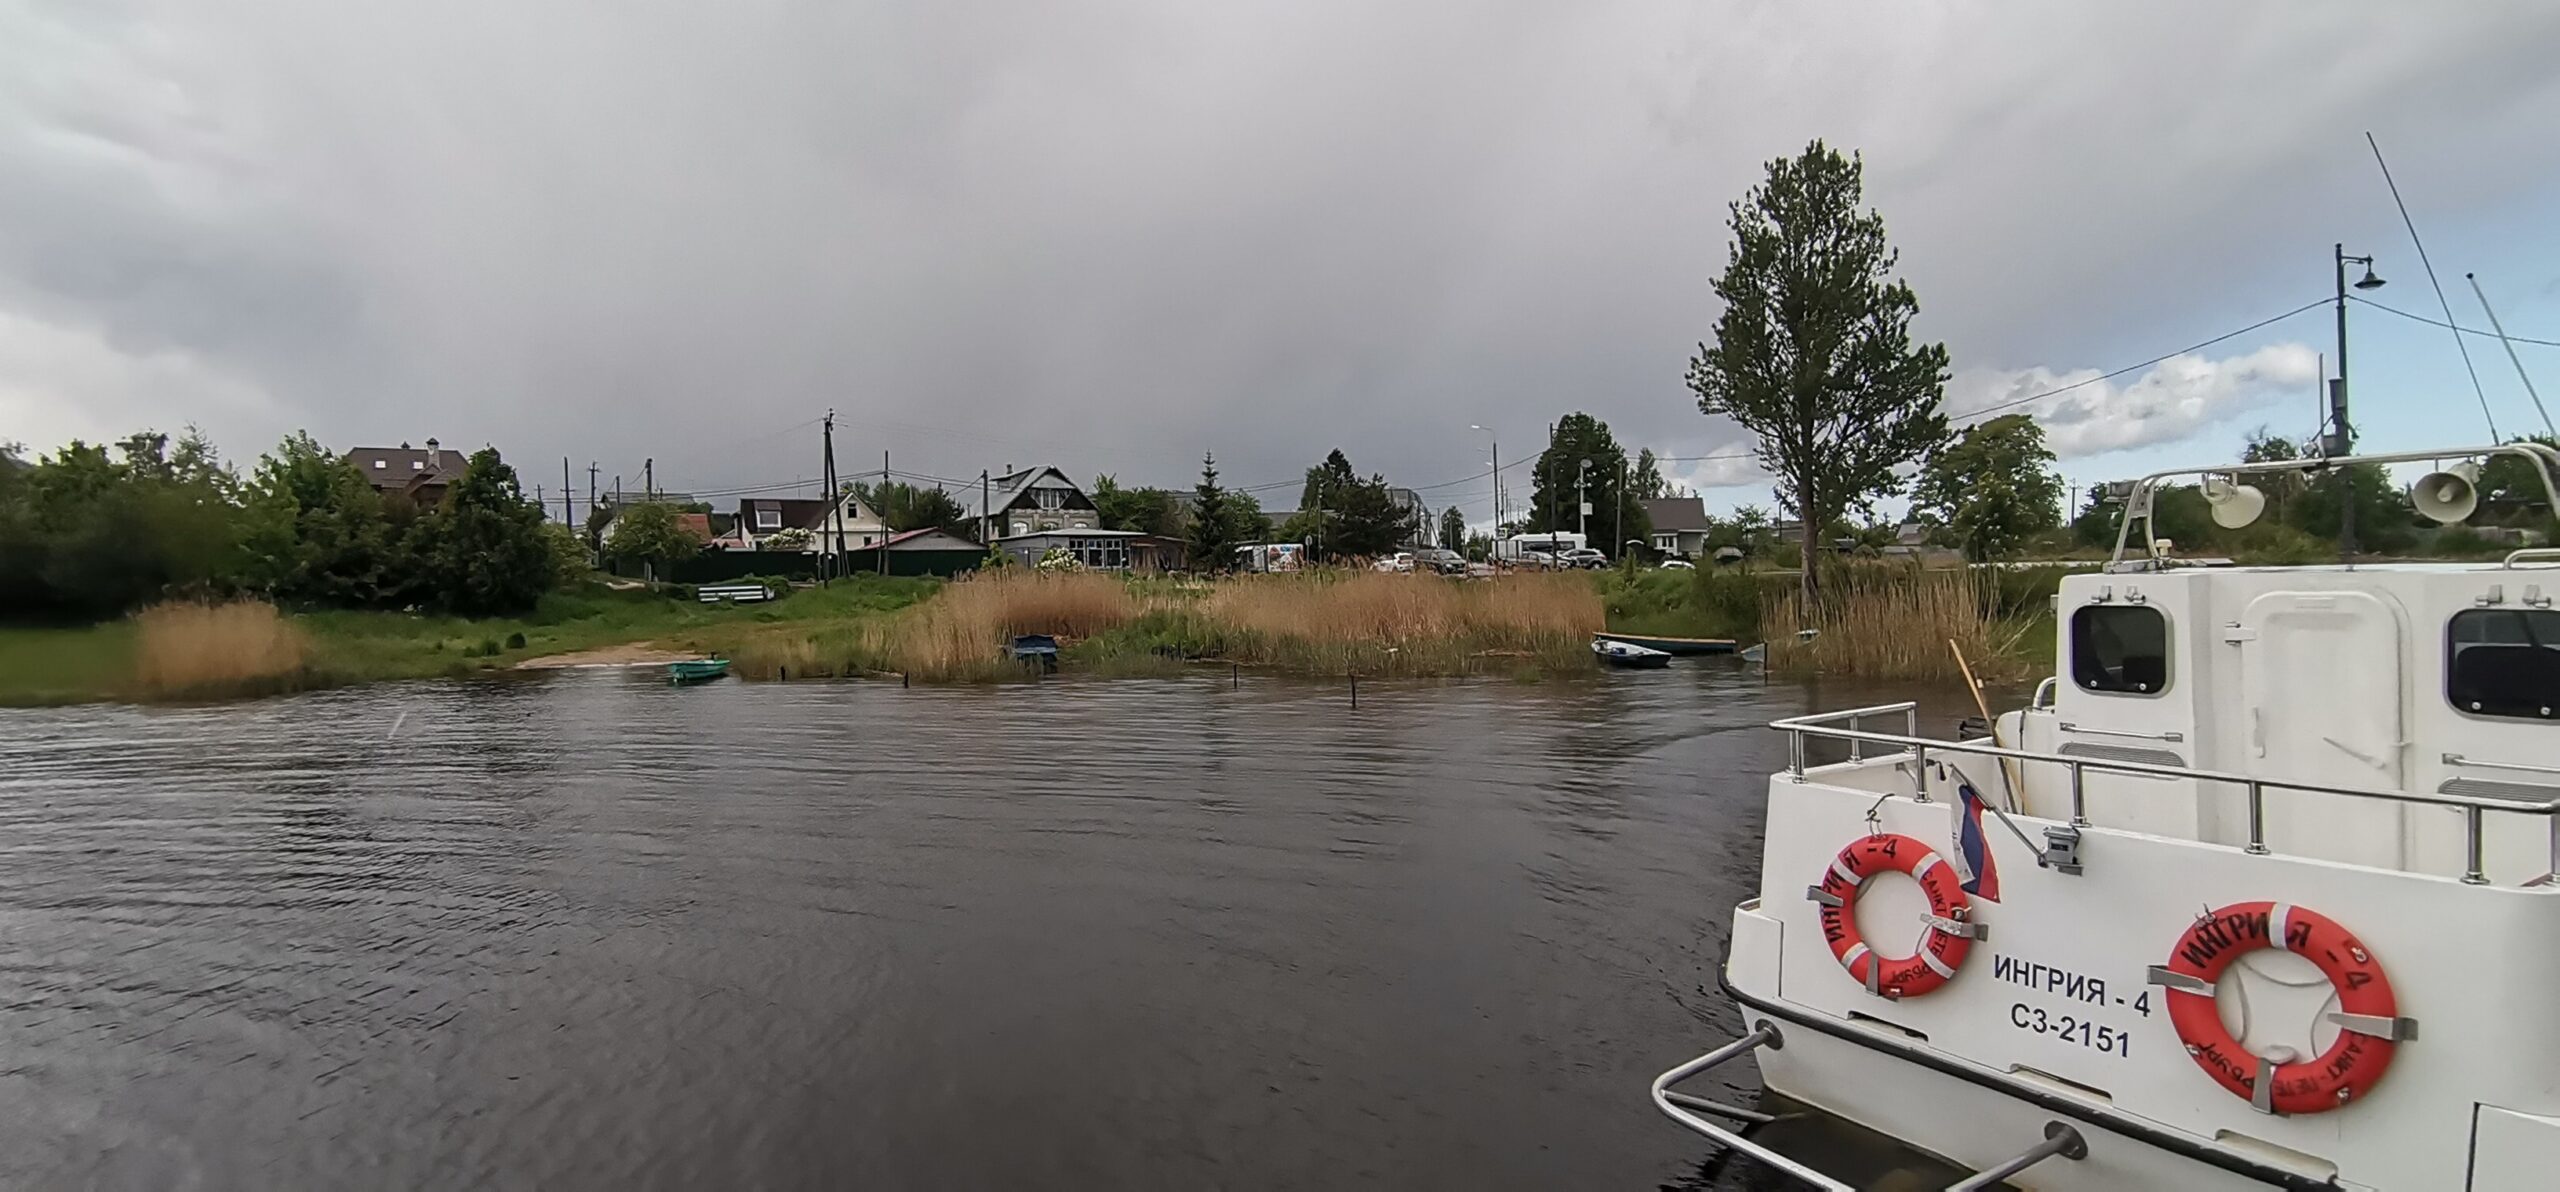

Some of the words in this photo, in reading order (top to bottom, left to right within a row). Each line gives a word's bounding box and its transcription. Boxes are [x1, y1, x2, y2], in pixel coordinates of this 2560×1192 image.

[1882, 838, 1898, 859] 4
[1994, 954, 2106, 1006] ИНГРИЯ
[2134, 991, 2151, 1018] 4
